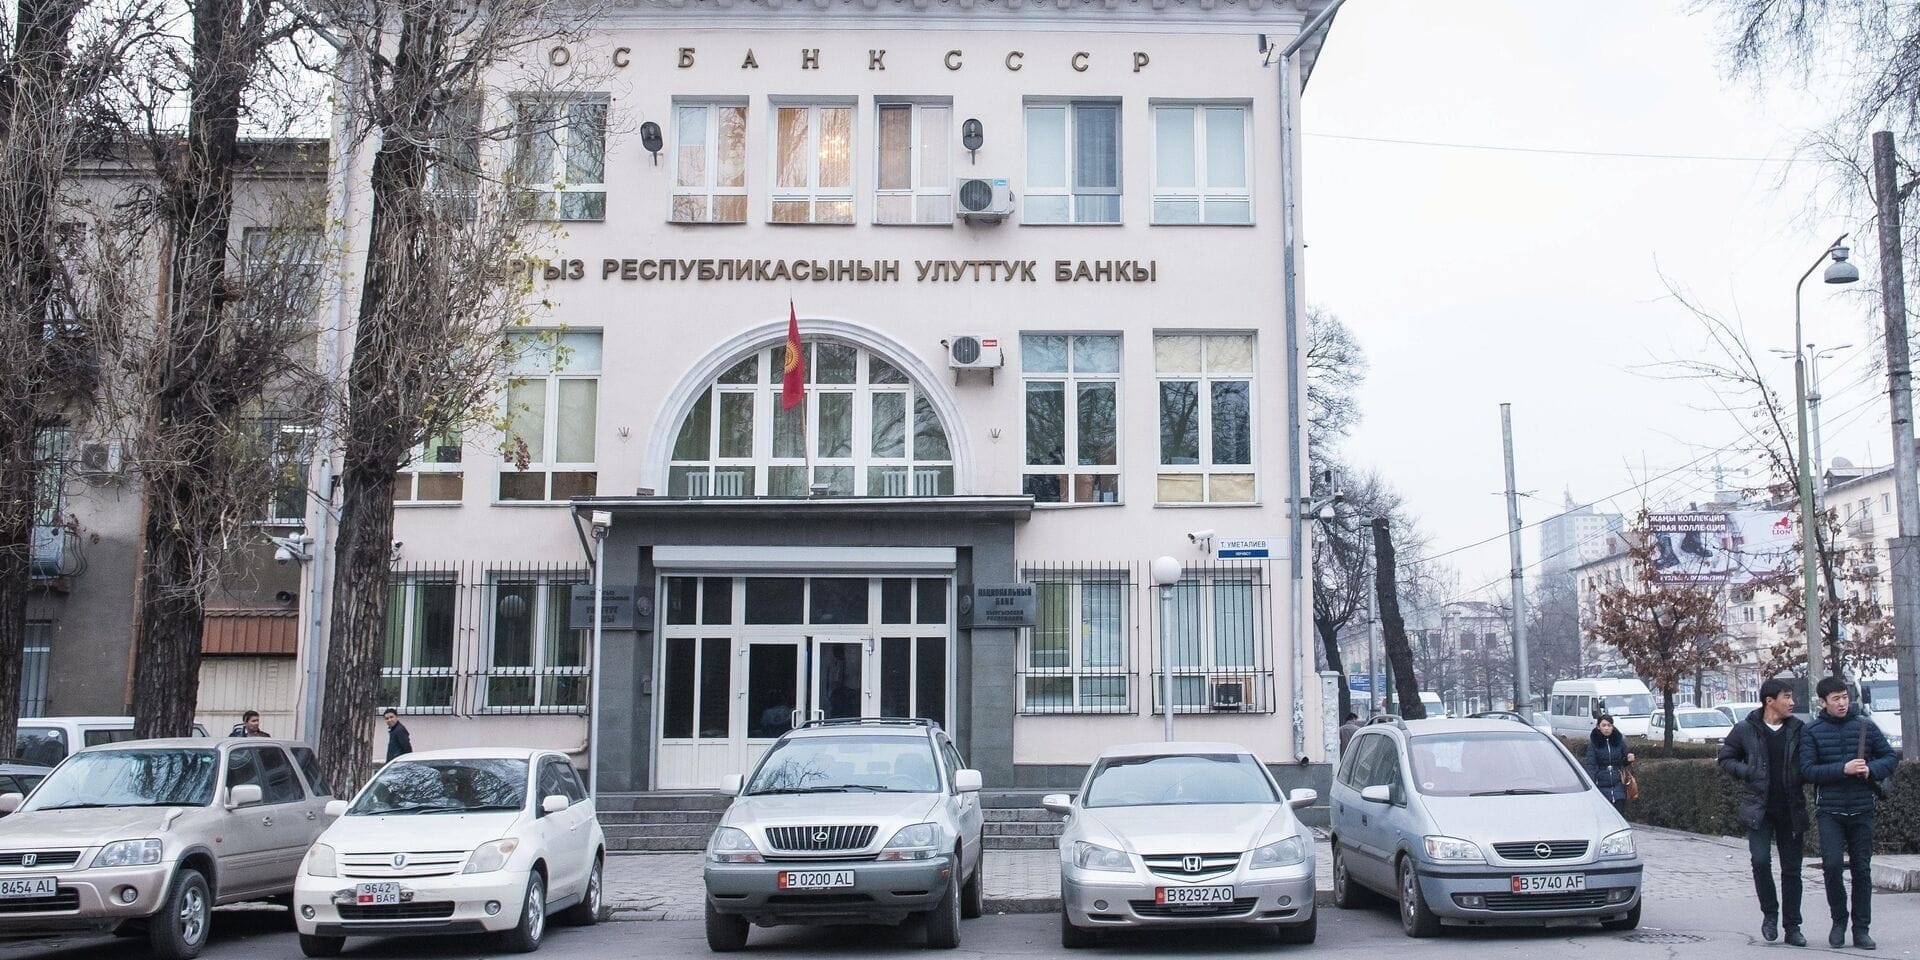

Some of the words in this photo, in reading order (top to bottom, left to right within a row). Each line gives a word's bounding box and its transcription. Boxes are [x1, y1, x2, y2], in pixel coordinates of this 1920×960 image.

[490, 45, 886, 70] ОСБАНК
[944, 49, 1150, 72] СССР
[602, 258, 900, 281] РЕСПУБЛИКАСЫНЫН
[914, 260, 1037, 281] УЛУТТУК
[1055, 260, 1157, 281] БАНКЫ
[1677, 514, 1725, 522] КОЛЛЕКЦИЯ
[788, 874, 797, 886] B
[800, 873, 831, 886] 0200
[834, 873, 853, 885] AL
[1520, 878, 1529, 890] B
[1532, 877, 1562, 890] 5740
[1565, 876, 1584, 889] AF
[1, 881, 32, 894] 8454
[36, 880, 54, 893] AL
[365, 883, 392, 894] 9642
[1178, 888, 1211, 902] 8292
